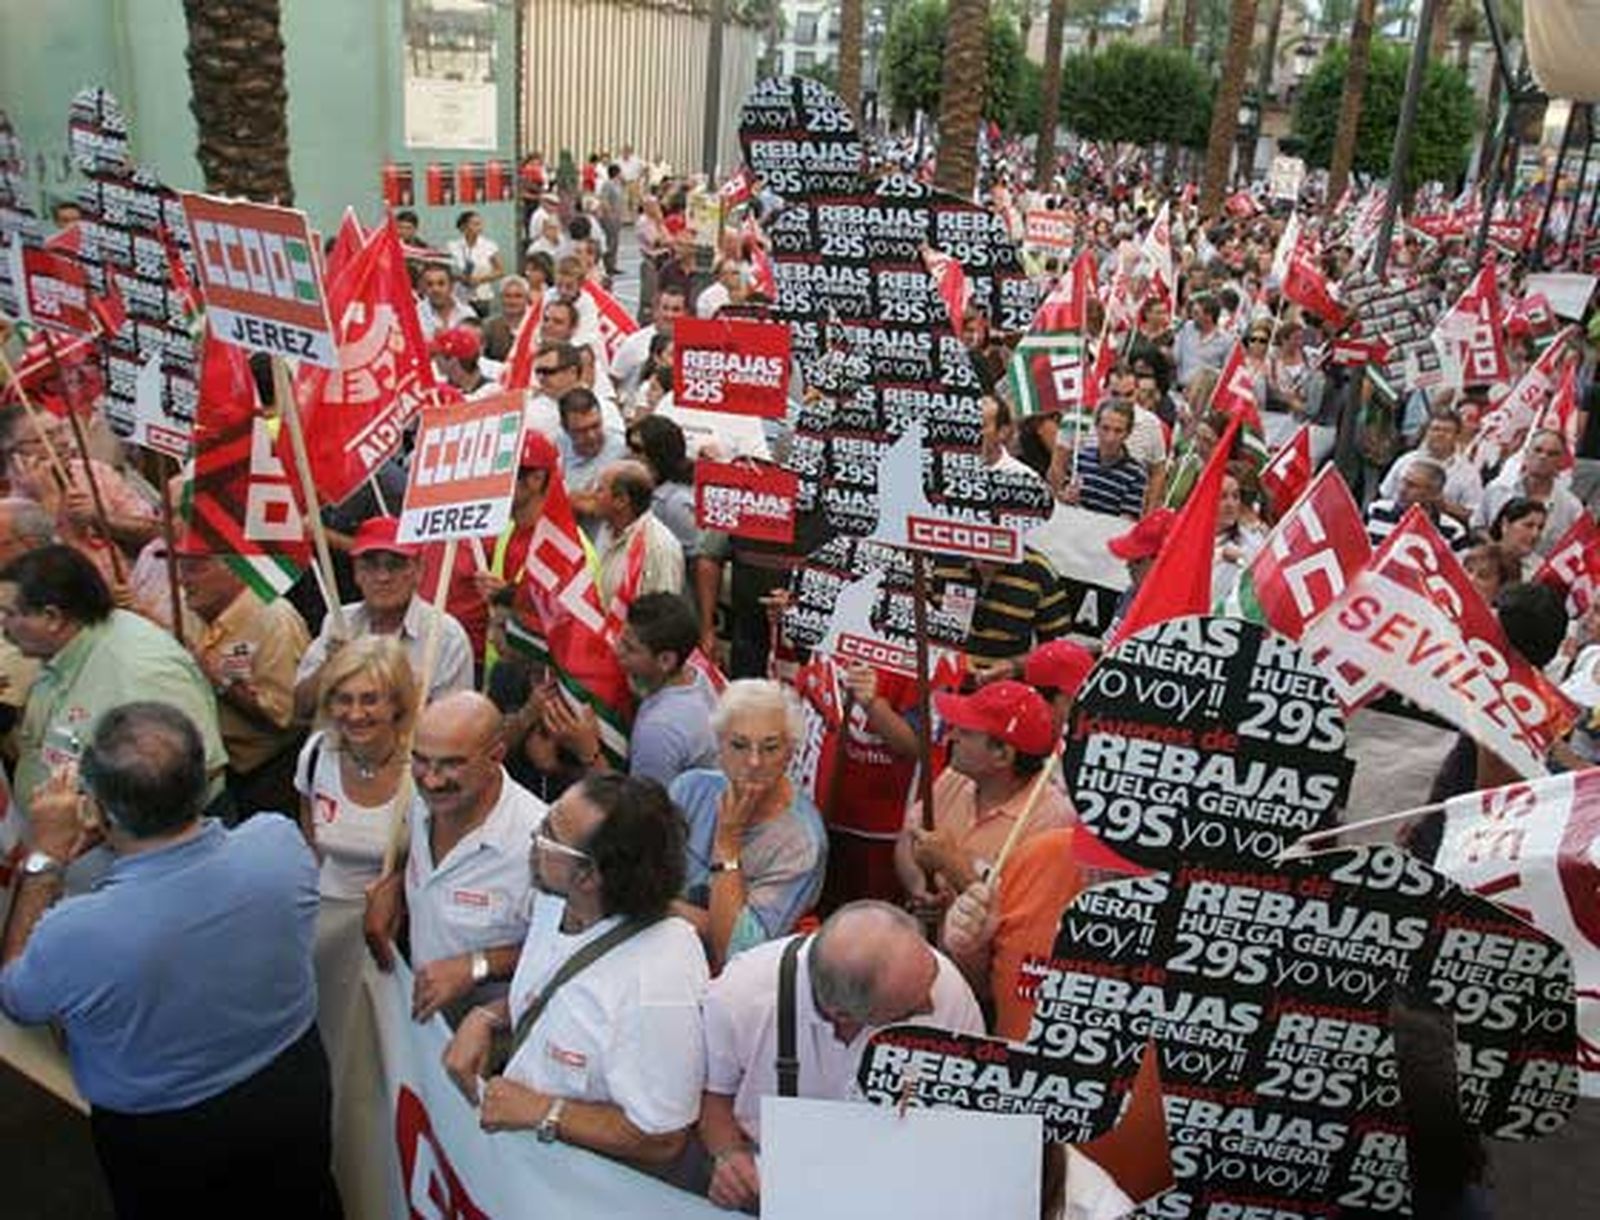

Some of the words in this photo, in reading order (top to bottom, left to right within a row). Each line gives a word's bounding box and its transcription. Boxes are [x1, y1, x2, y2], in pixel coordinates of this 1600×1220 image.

[805, 108, 854, 133] 29S
[751, 140, 861, 161] REBAJAS
[875, 176, 923, 198] 29S
[818, 205, 928, 228] REBAJAS
[192, 219, 297, 298] CCOO
[821, 234, 866, 257] 29S
[880, 300, 926, 324] 29S
[230, 316, 320, 361] JEREZ
[682, 350, 784, 376] REBAJAS
[682, 380, 725, 404] 29S
[416, 414, 500, 487] CCOO
[834, 460, 876, 485] 29S
[943, 477, 988, 500] 29S
[415, 503, 492, 537] JEREZ
[914, 524, 990, 549] CCOO
[841, 637, 903, 663] CCOO
[1238, 693, 1346, 751] 29S
[1077, 766, 1190, 807] HUELGA
[1083, 732, 1340, 811] REBAJAS
[1074, 790, 1177, 847] 29S
[1178, 816, 1227, 850] yo
[1330, 845, 1435, 897] 29S
[1184, 880, 1428, 950] REBAJAS
[1166, 933, 1273, 984] 29S
[1272, 957, 1319, 987] yo
[1178, 910, 1285, 949] HUELGA
[1292, 932, 1412, 972] GENERAL
[1430, 957, 1535, 997] HUELGA
[1428, 979, 1522, 1031] 29S
[1522, 1004, 1568, 1034] yo
[1129, 1016, 1249, 1053] GENERAL
[868, 1044, 1106, 1110] REBAJAS
[1267, 1041, 1369, 1075] HUELGA
[1256, 1061, 1359, 1107] 29S
[1355, 1080, 1401, 1111] yo
[977, 1090, 1094, 1126] GENERAL
[1162, 1095, 1349, 1152] EBAJAS
[1203, 1153, 1245, 1181] yo
[1220, 1134, 1331, 1168] GENERAL
